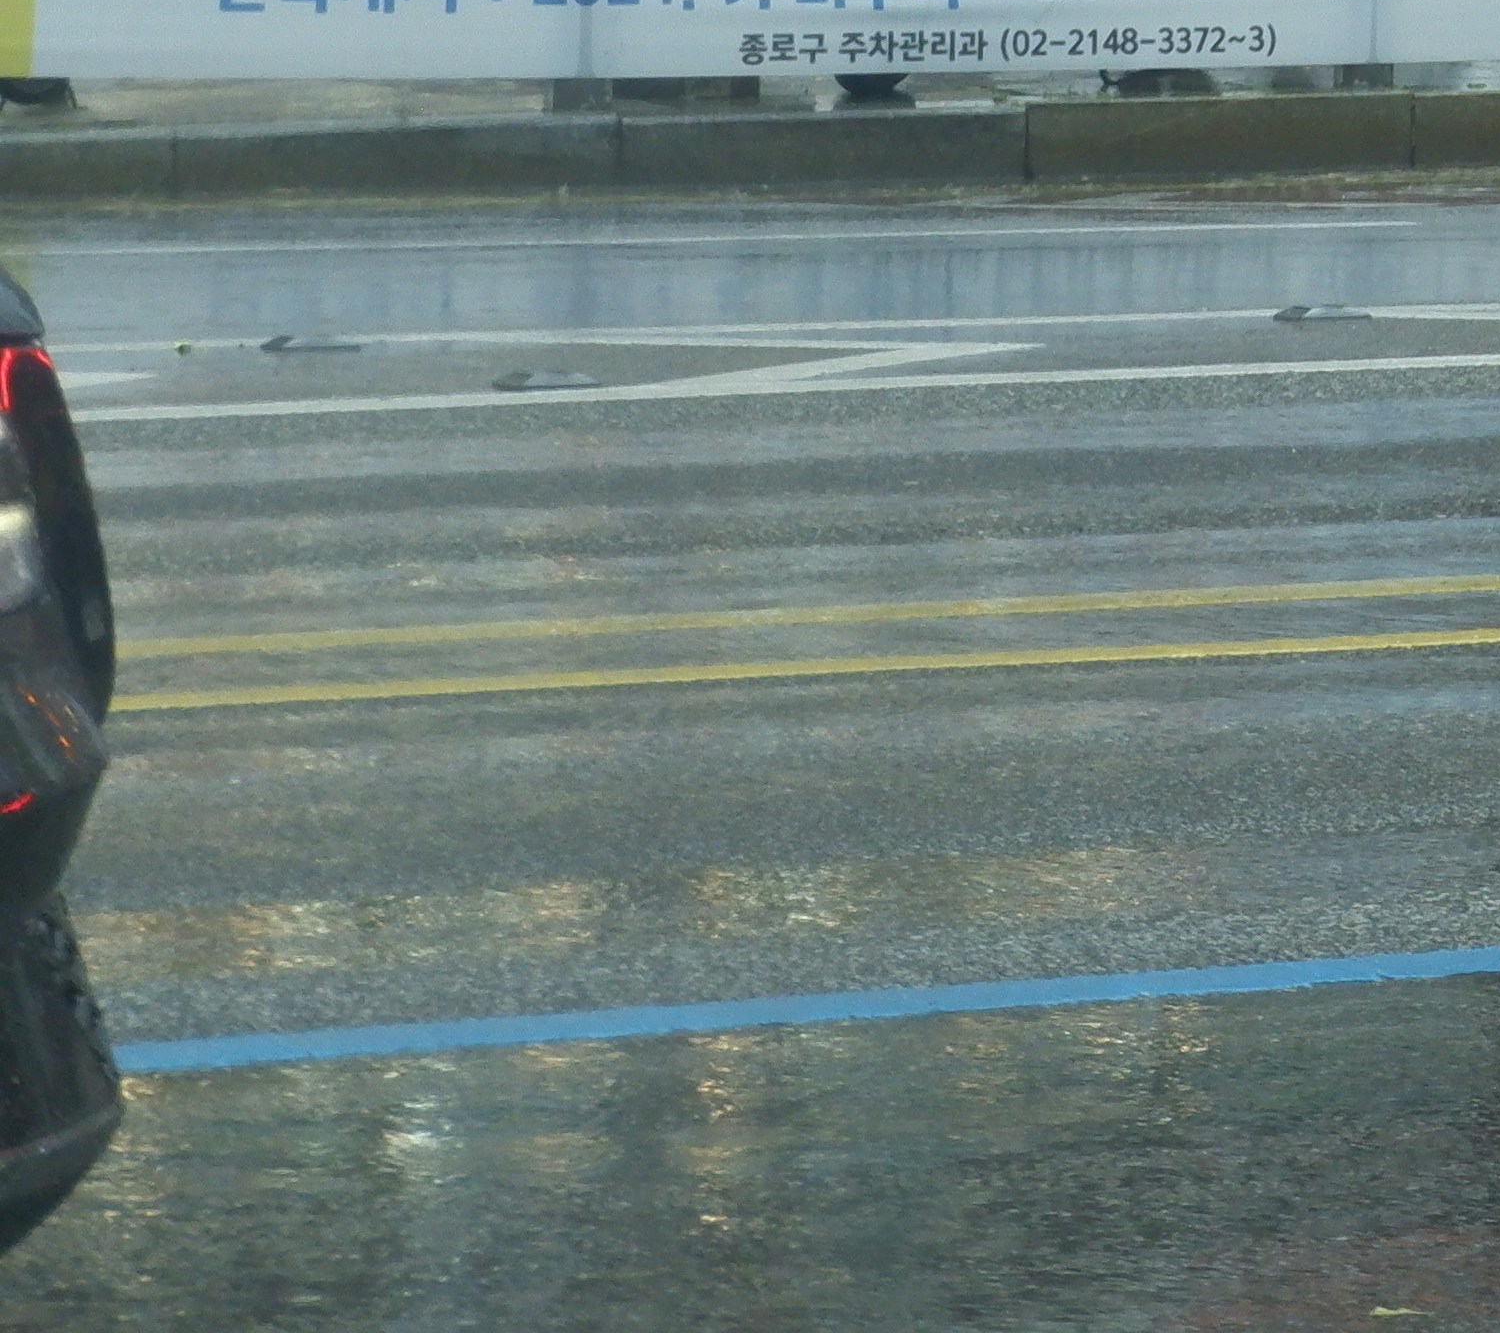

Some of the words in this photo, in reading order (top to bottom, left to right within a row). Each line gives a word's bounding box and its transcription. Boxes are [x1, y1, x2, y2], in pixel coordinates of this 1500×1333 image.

[738, 31, 829, 64] 종로구
[838, 29, 988, 64] 주차관리과
[999, 23, 1278, 61] (02-2148-3372~3)
